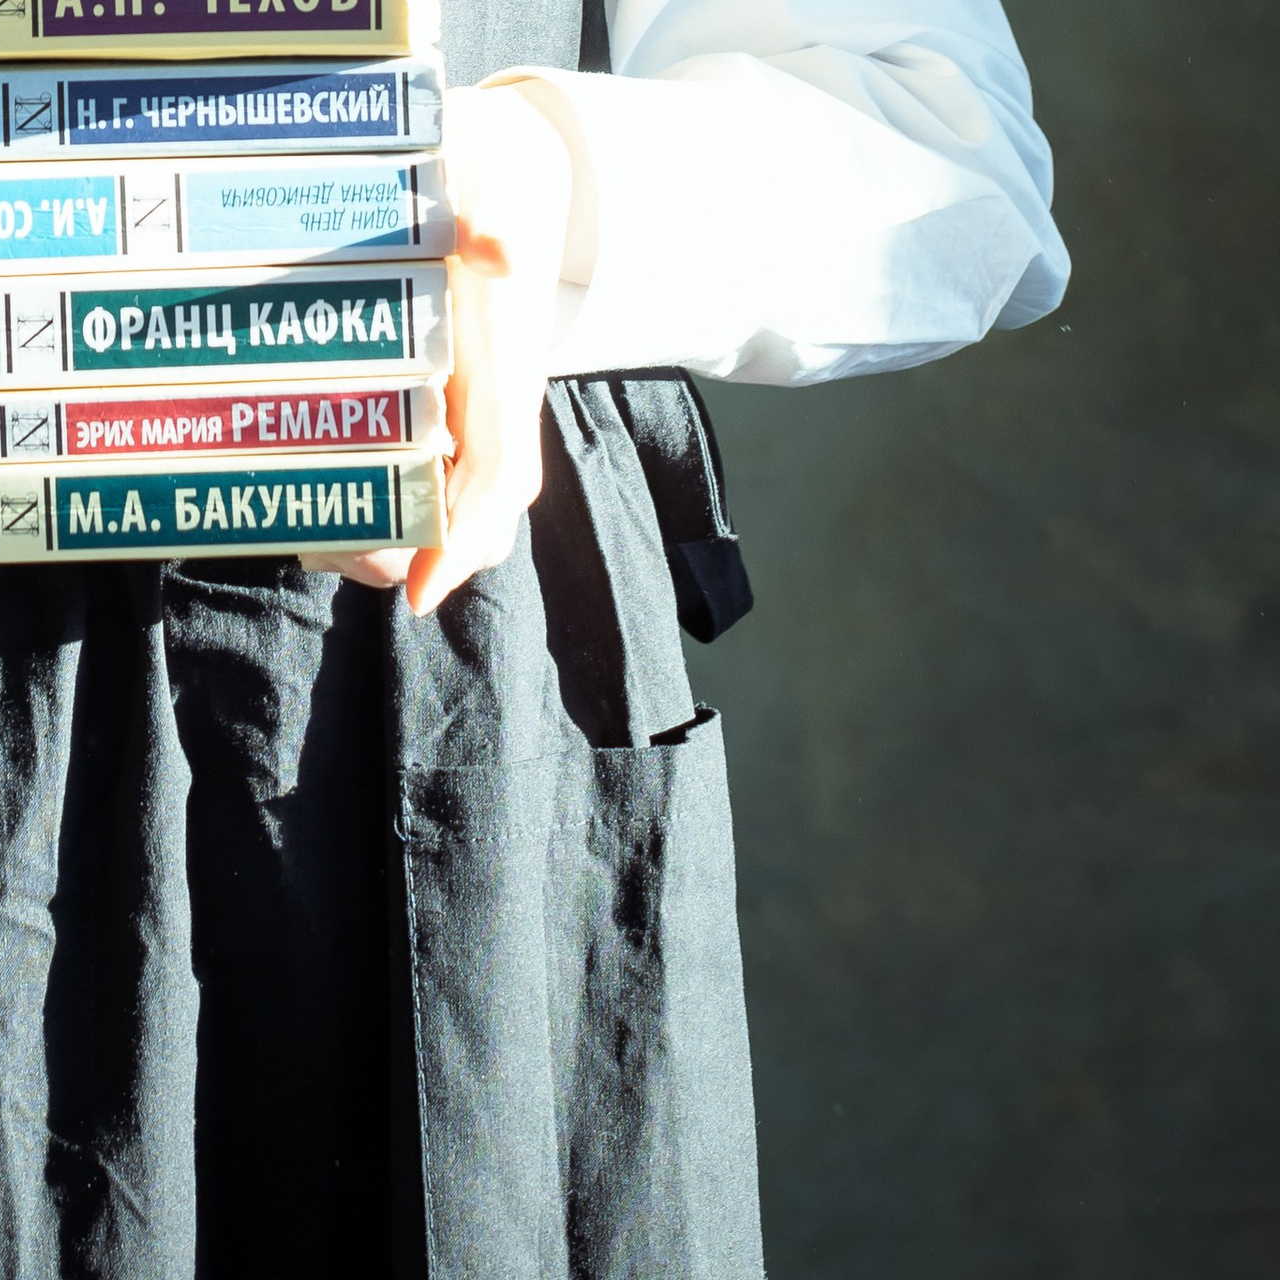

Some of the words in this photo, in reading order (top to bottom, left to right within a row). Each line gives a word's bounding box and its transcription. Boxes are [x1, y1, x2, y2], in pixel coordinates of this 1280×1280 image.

[140, 84, 390, 128] ЧЕРНЫШЕВСКИЙ
[222, 182, 335, 207] ДЕНИСОВИЧА
[341, 183, 398, 203] ИВАНА
[300, 208, 344, 231] ДЕНЬ
[352, 207, 399, 230] ОДИН
[82, 304, 236, 355] ФРАНЦ
[250, 298, 398, 346] КАФКА
[76, 420, 135, 449] ЭРИХ
[141, 415, 222, 445] МАРИЯ
[231, 397, 391, 442] РЕМАРК
[69, 490, 161, 535] М.А.
[175, 482, 374, 531] БАКУНИН
